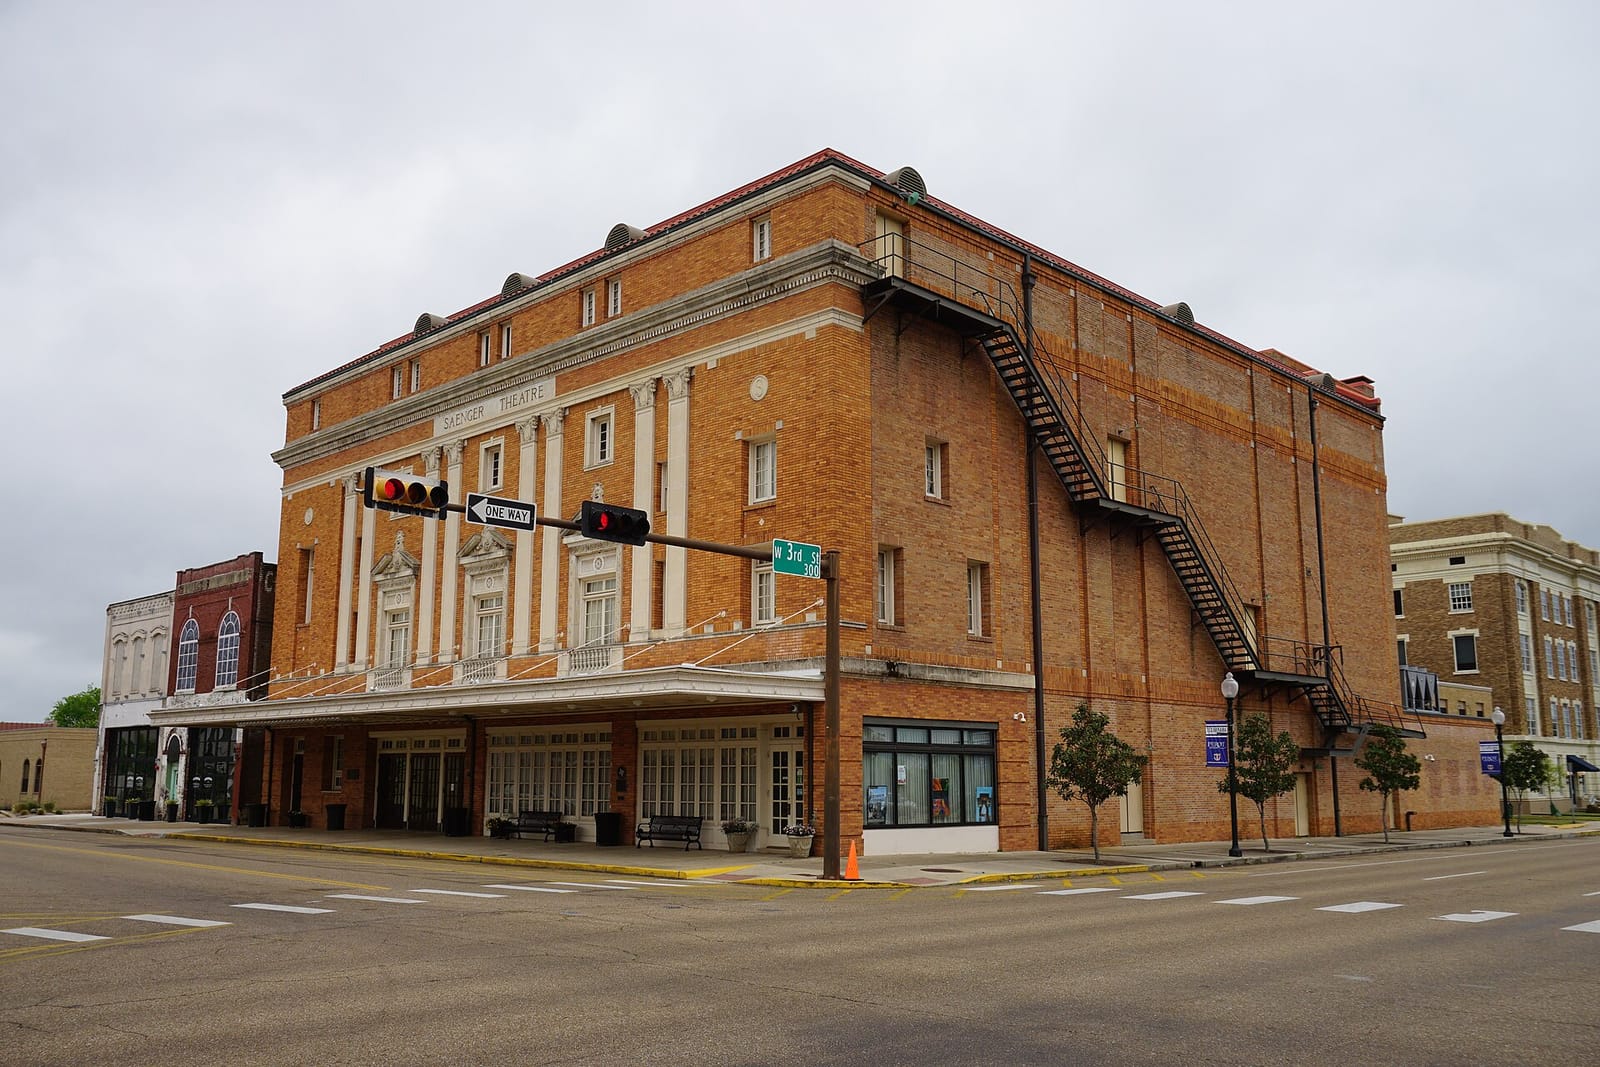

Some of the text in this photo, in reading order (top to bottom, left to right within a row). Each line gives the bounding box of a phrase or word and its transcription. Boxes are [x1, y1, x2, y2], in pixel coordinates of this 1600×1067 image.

[443, 385, 544, 429] SAENGER THEATRE
[486, 505, 529, 521] ONE WAY
[775, 543, 819, 564] W 3rd St
[804, 563, 819, 577] 300
